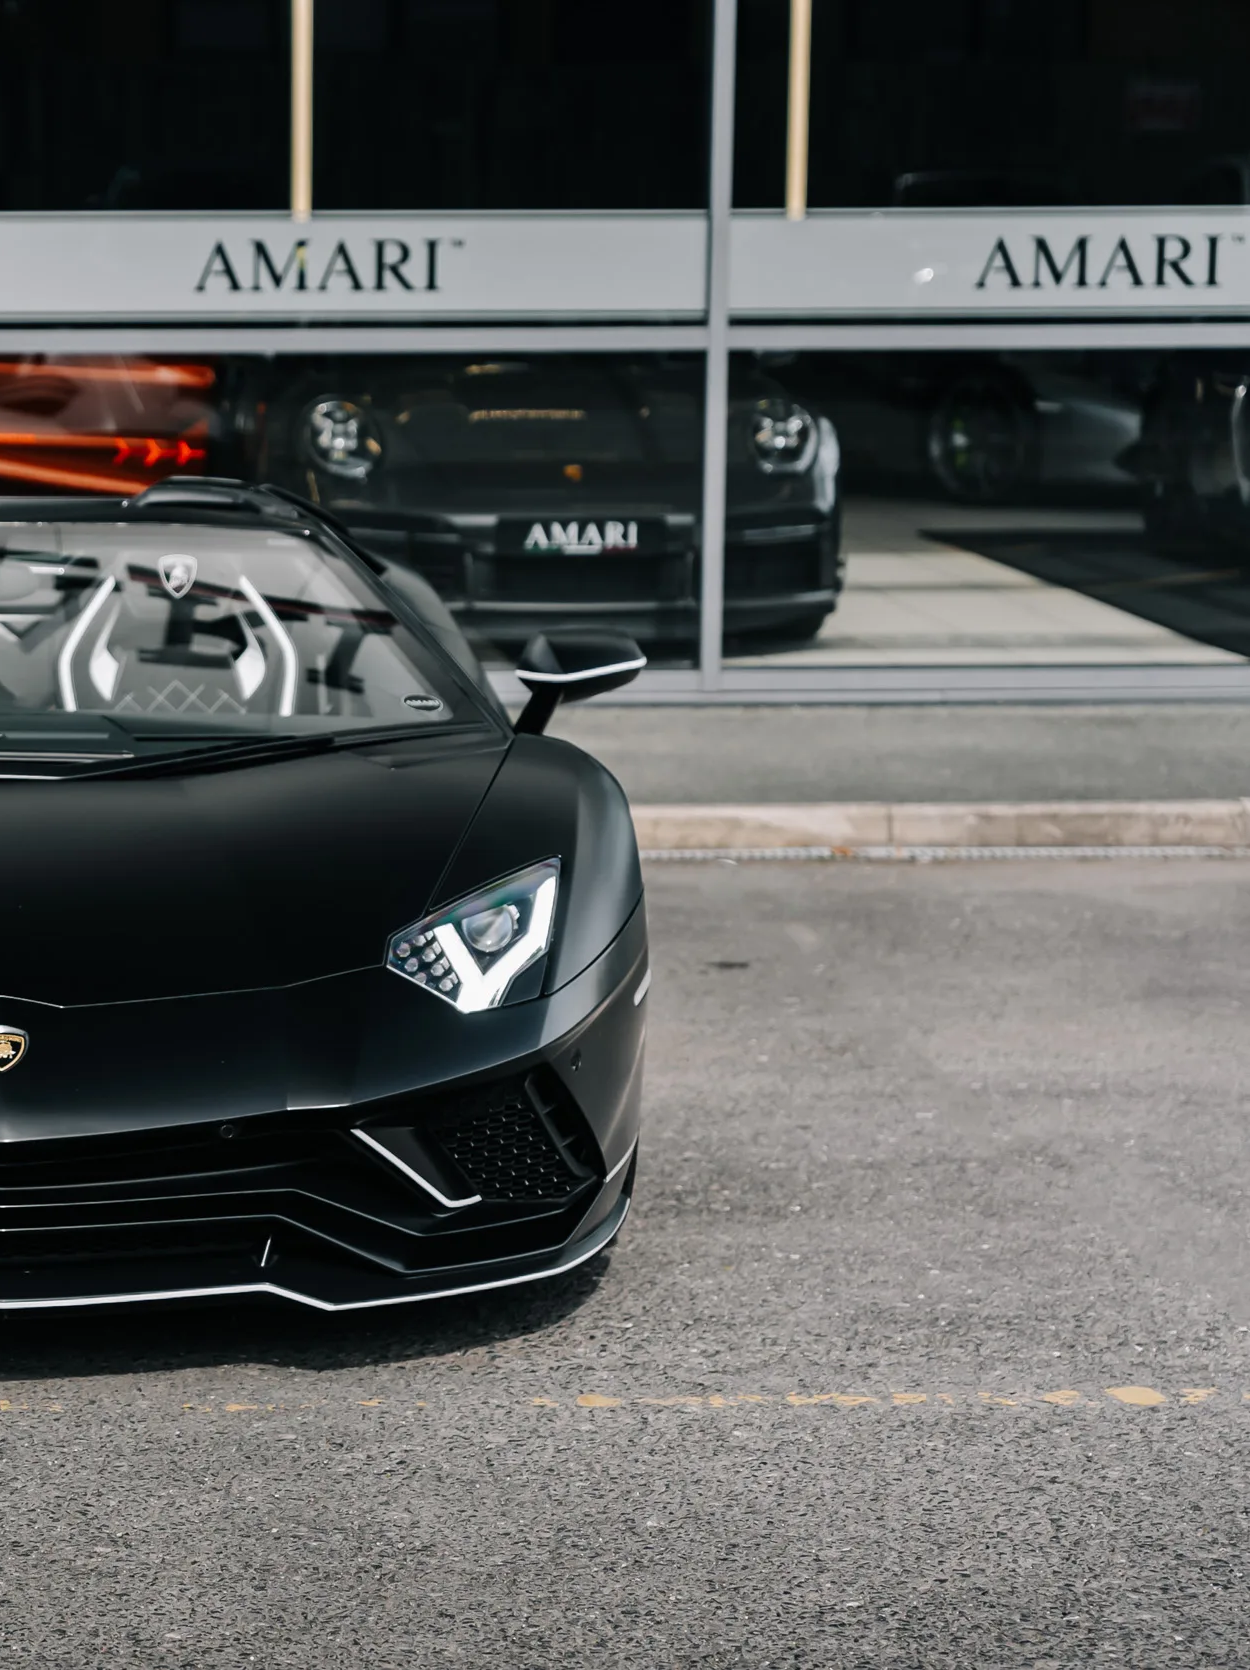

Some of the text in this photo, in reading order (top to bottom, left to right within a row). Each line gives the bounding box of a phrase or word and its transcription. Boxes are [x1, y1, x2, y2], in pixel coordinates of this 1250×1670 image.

[194, 238, 442, 292] AMARI
[974, 234, 1223, 290] AMARI
[524, 521, 638, 549] AMARI
